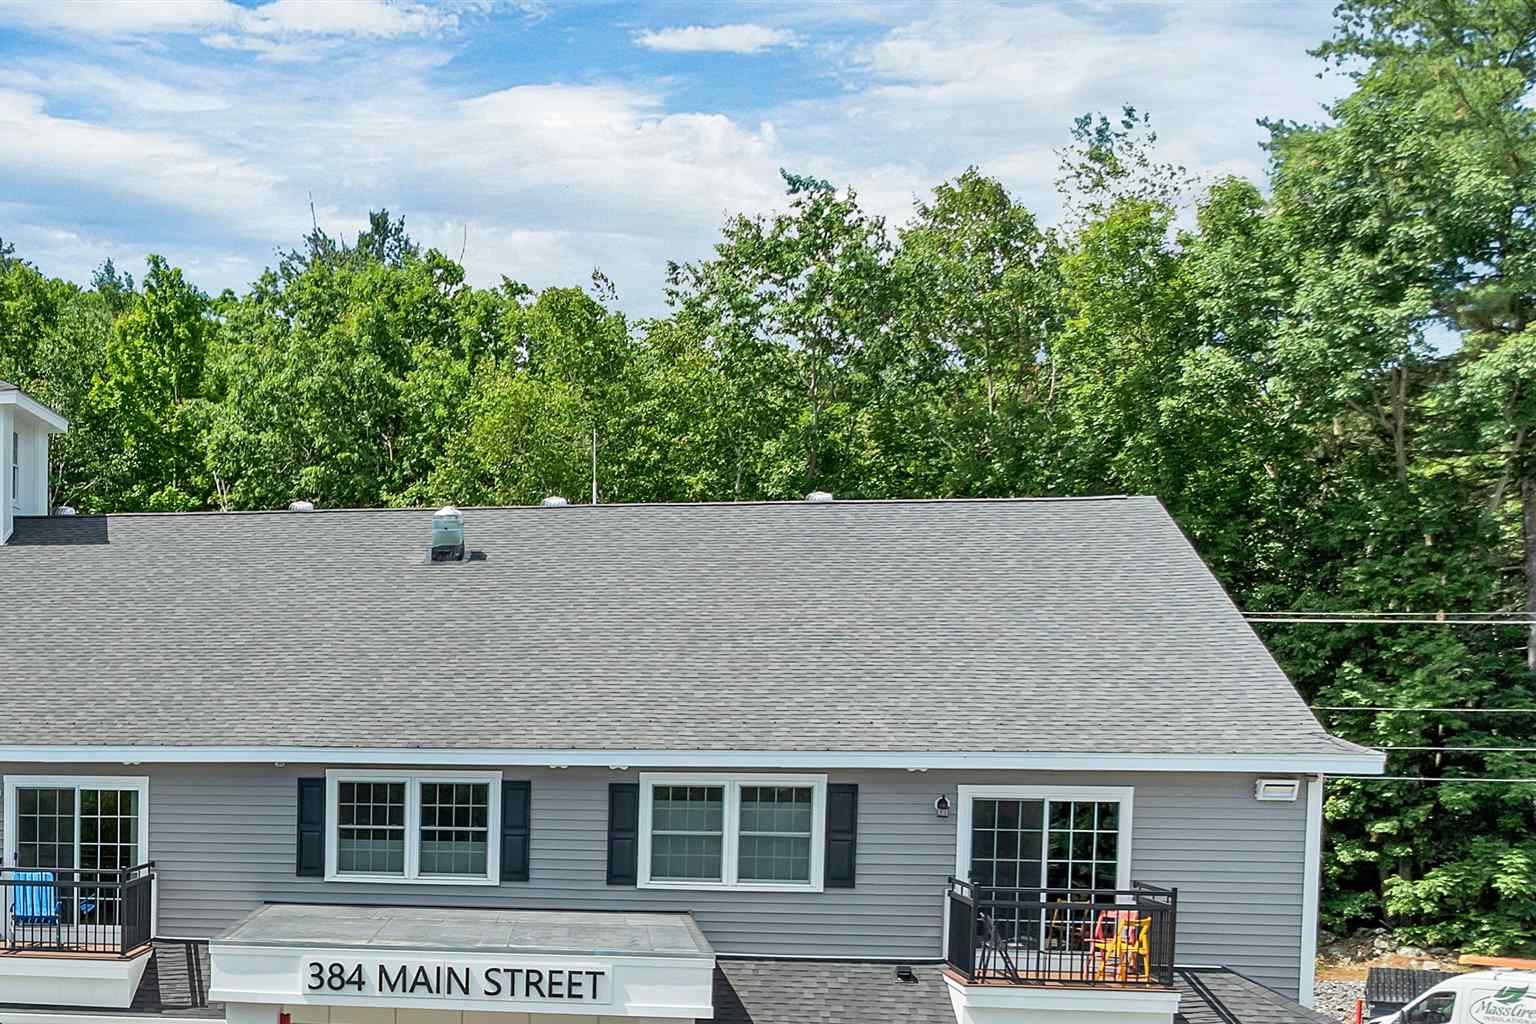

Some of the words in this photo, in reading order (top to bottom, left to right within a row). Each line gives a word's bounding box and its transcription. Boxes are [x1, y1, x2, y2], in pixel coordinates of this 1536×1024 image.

[307, 961, 366, 992] 384
[377, 963, 471, 995] MAIN
[483, 967, 606, 1000] STREET
